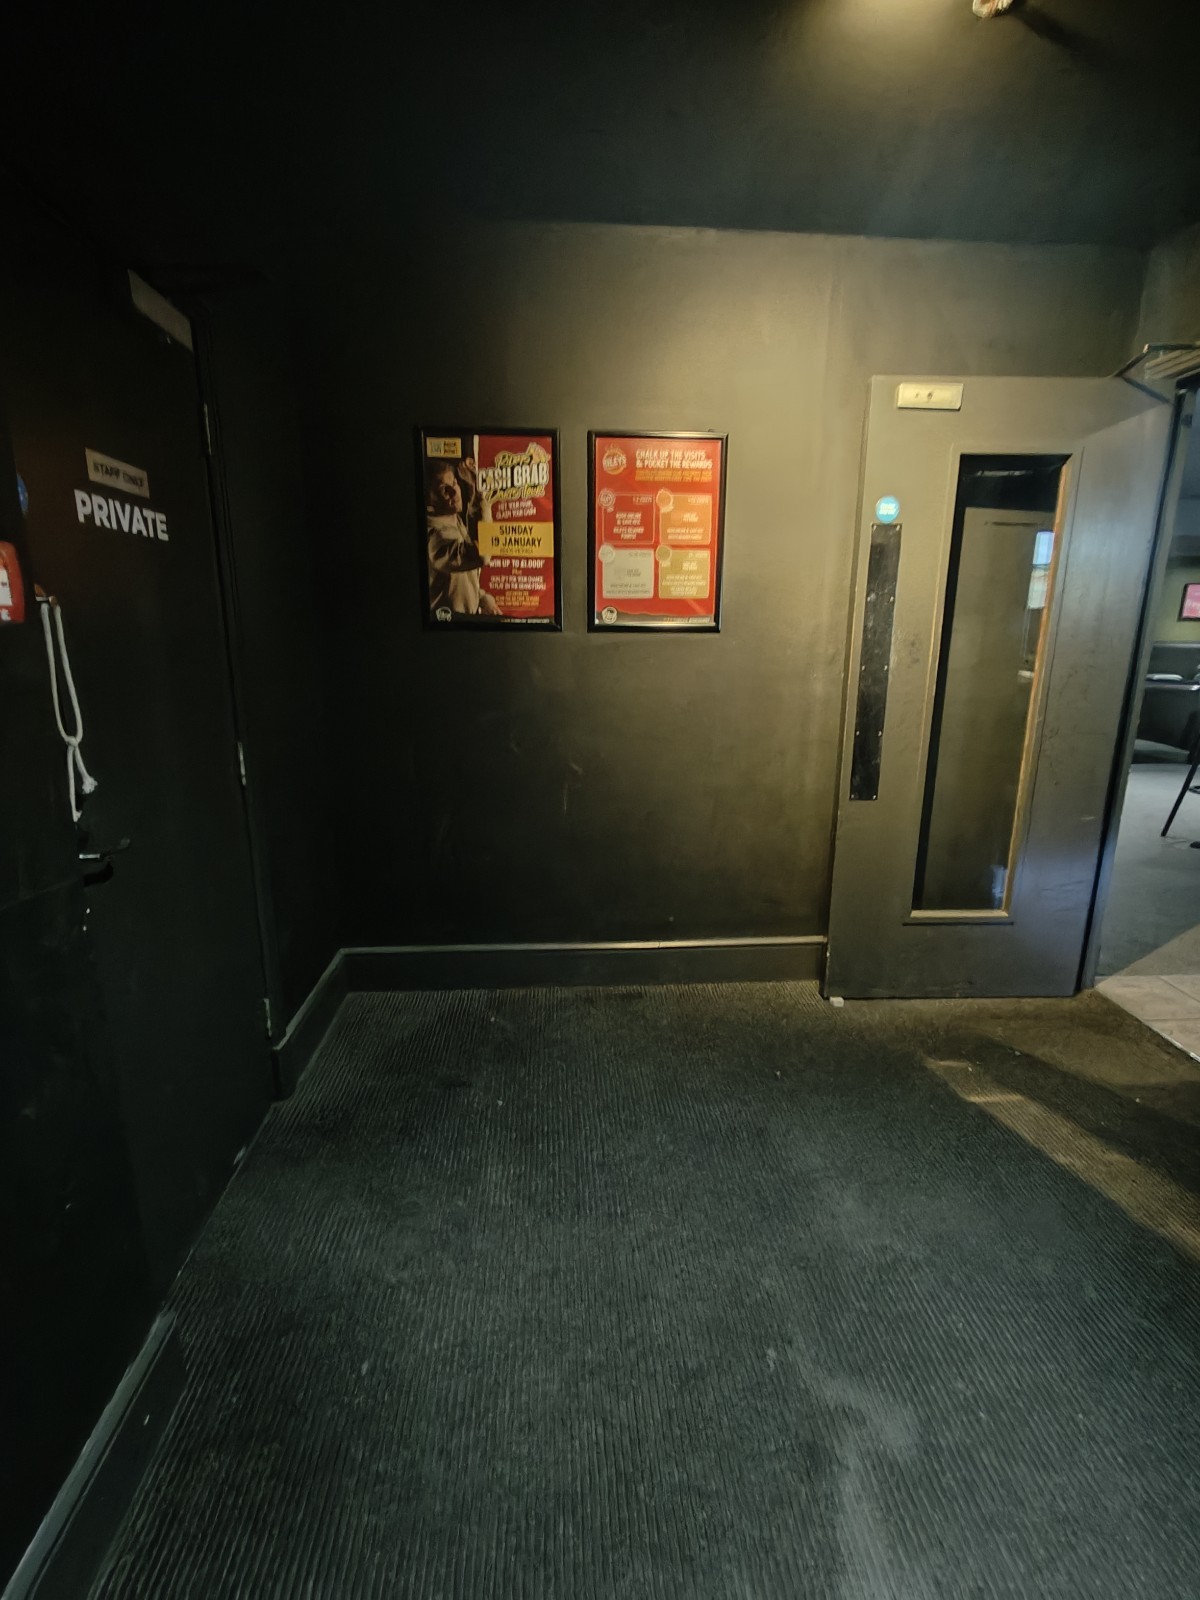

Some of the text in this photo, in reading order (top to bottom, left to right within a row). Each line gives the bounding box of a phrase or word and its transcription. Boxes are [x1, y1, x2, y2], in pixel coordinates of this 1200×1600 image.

[635, 450, 706, 460] CHALK UP THE VISITS
[644, 459, 669, 468] POCKET
[669, 459, 681, 468] THE
[682, 459, 713, 469] REWARDS
[92, 461, 120, 479] STAFF
[479, 462, 548, 492] CASH GRAB
[73, 489, 170, 541] PRIVATE
[499, 525, 533, 536] SUNDAY
[491, 536, 542, 548] 19 JANUARY
[502, 559, 511, 568] UP
[512, 559, 519, 568] TO
